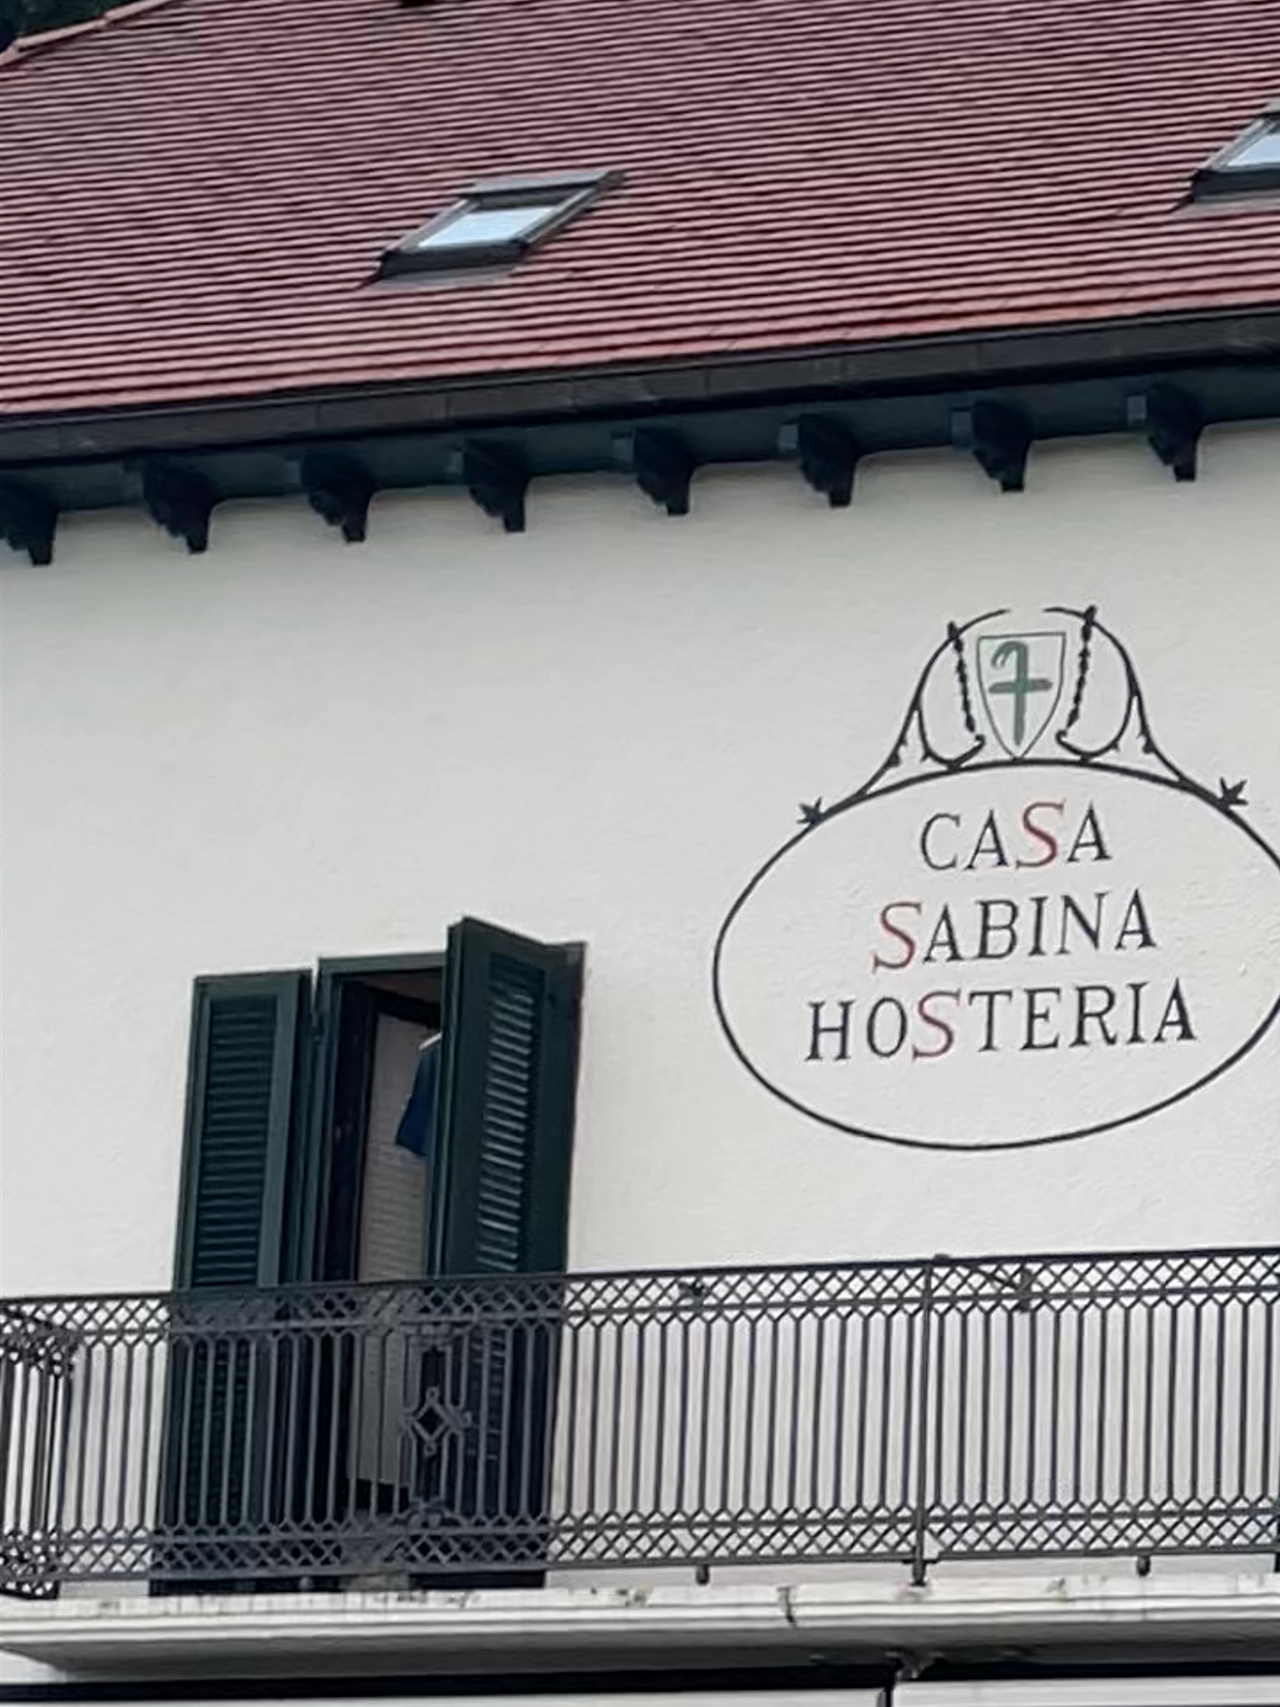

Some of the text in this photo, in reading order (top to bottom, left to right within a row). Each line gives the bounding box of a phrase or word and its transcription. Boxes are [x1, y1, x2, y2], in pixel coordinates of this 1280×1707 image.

[919, 798, 1113, 872] CASA
[871, 888, 1158, 975] SABINA
[804, 978, 1198, 1062] HOSTERIA
